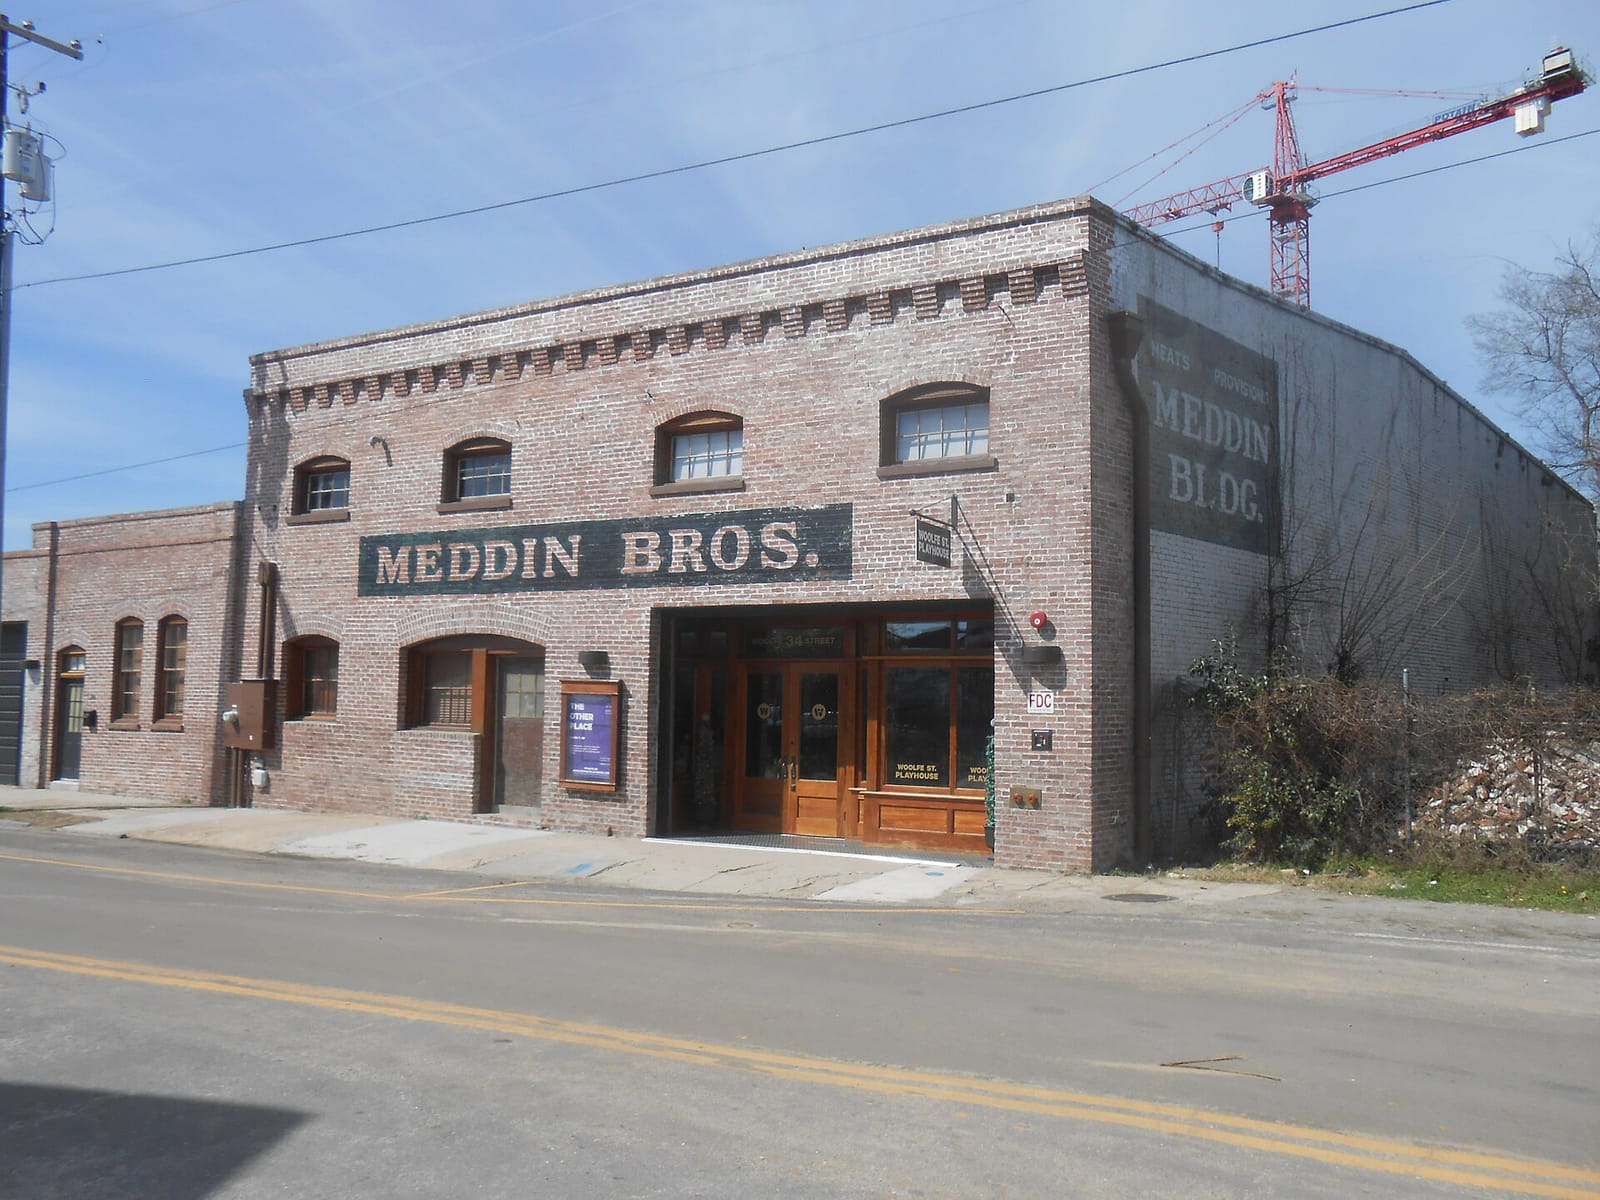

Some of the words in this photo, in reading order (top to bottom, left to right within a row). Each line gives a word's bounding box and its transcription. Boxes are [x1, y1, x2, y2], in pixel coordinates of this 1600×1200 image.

[1435, 103, 1476, 122] POTAIN
[1151, 340, 1191, 371] MEATS
[1152, 381, 1271, 465] MEDDIN
[1168, 454, 1264, 523] BLDG.
[375, 534, 583, 585] MEDDIN
[620, 521, 820, 576] BROS.
[919, 541, 949, 559] PLAYHOUSE
[570, 702, 585, 711] THE
[1029, 693, 1051, 708] FDC
[569, 712, 594, 721] OTHER
[569, 722, 593, 731] PLACE
[897, 763, 925, 771] WOOLFE
[895, 771, 939, 780] PLAYHOUSE
